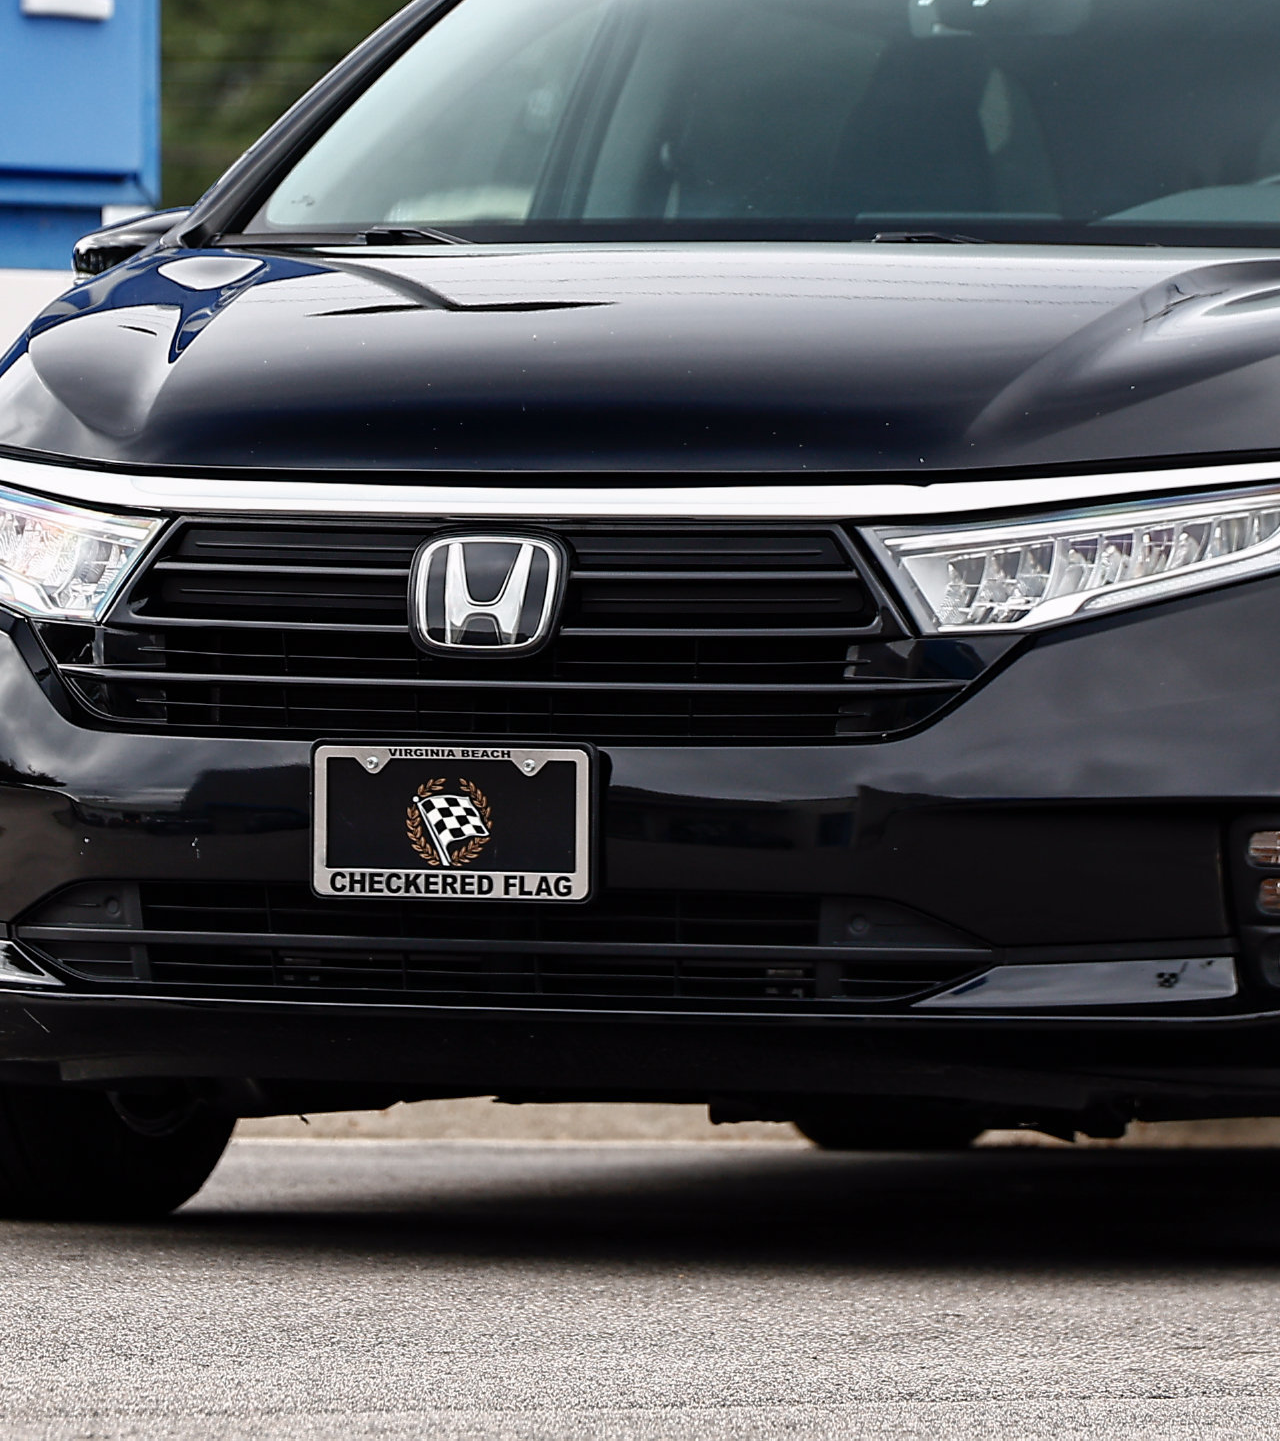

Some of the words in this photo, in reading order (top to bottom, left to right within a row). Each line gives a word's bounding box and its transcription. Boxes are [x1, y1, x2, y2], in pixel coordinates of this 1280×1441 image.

[388, 748, 456, 758] VIRGINIA
[461, 749, 511, 759] BEACH
[330, 871, 494, 895] CHECKERED
[503, 875, 572, 897] FLAG
